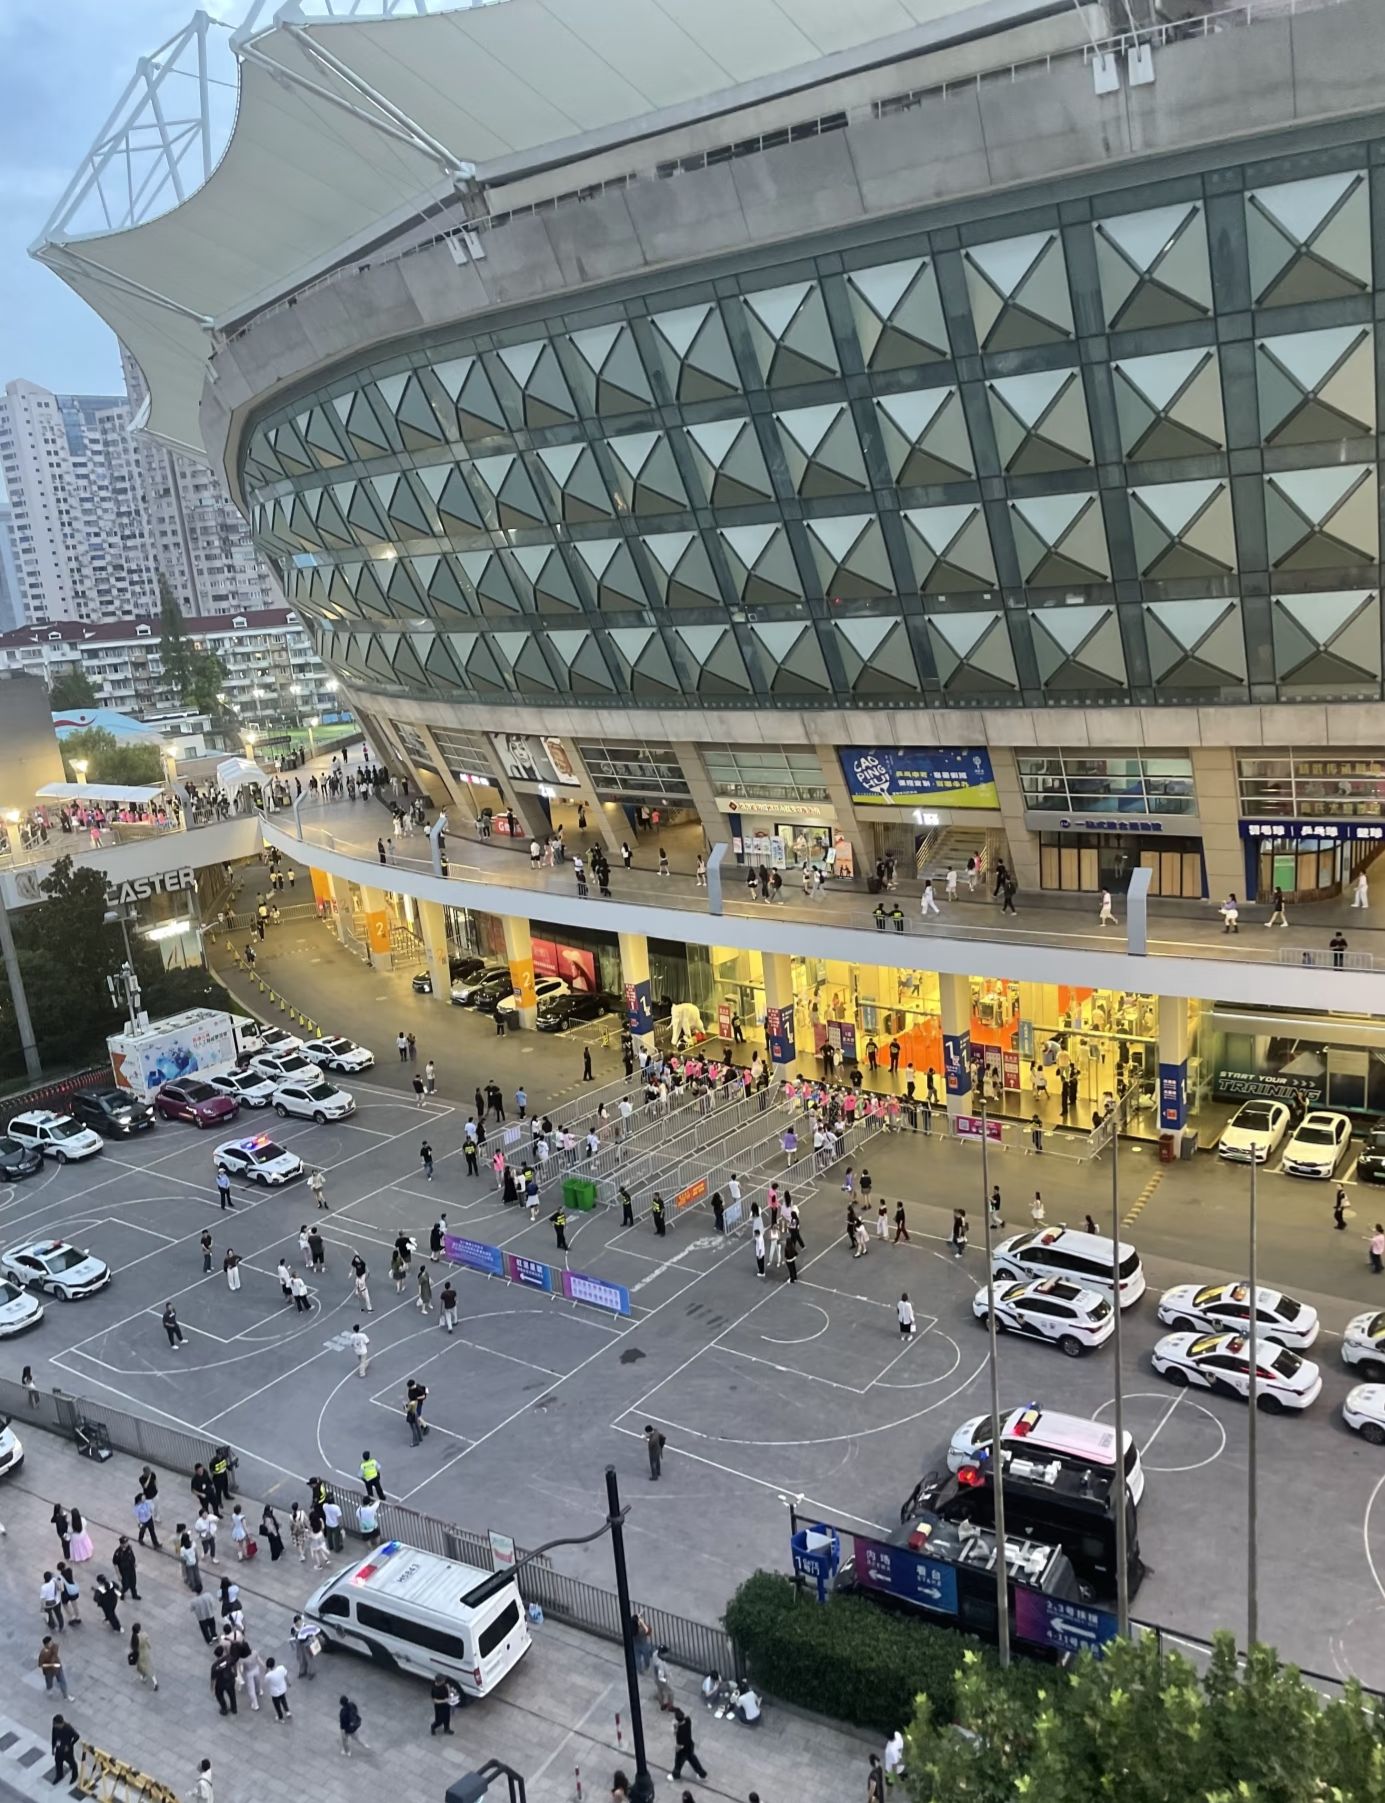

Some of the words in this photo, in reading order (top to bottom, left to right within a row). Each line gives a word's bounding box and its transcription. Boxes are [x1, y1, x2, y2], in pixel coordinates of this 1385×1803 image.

[853, 755, 879, 772] CAO
[856, 765, 887, 782] PING
[863, 774, 890, 789] HUI
[1219, 1070, 1256, 1080] START
[1259, 1075, 1288, 1085] YOUR
